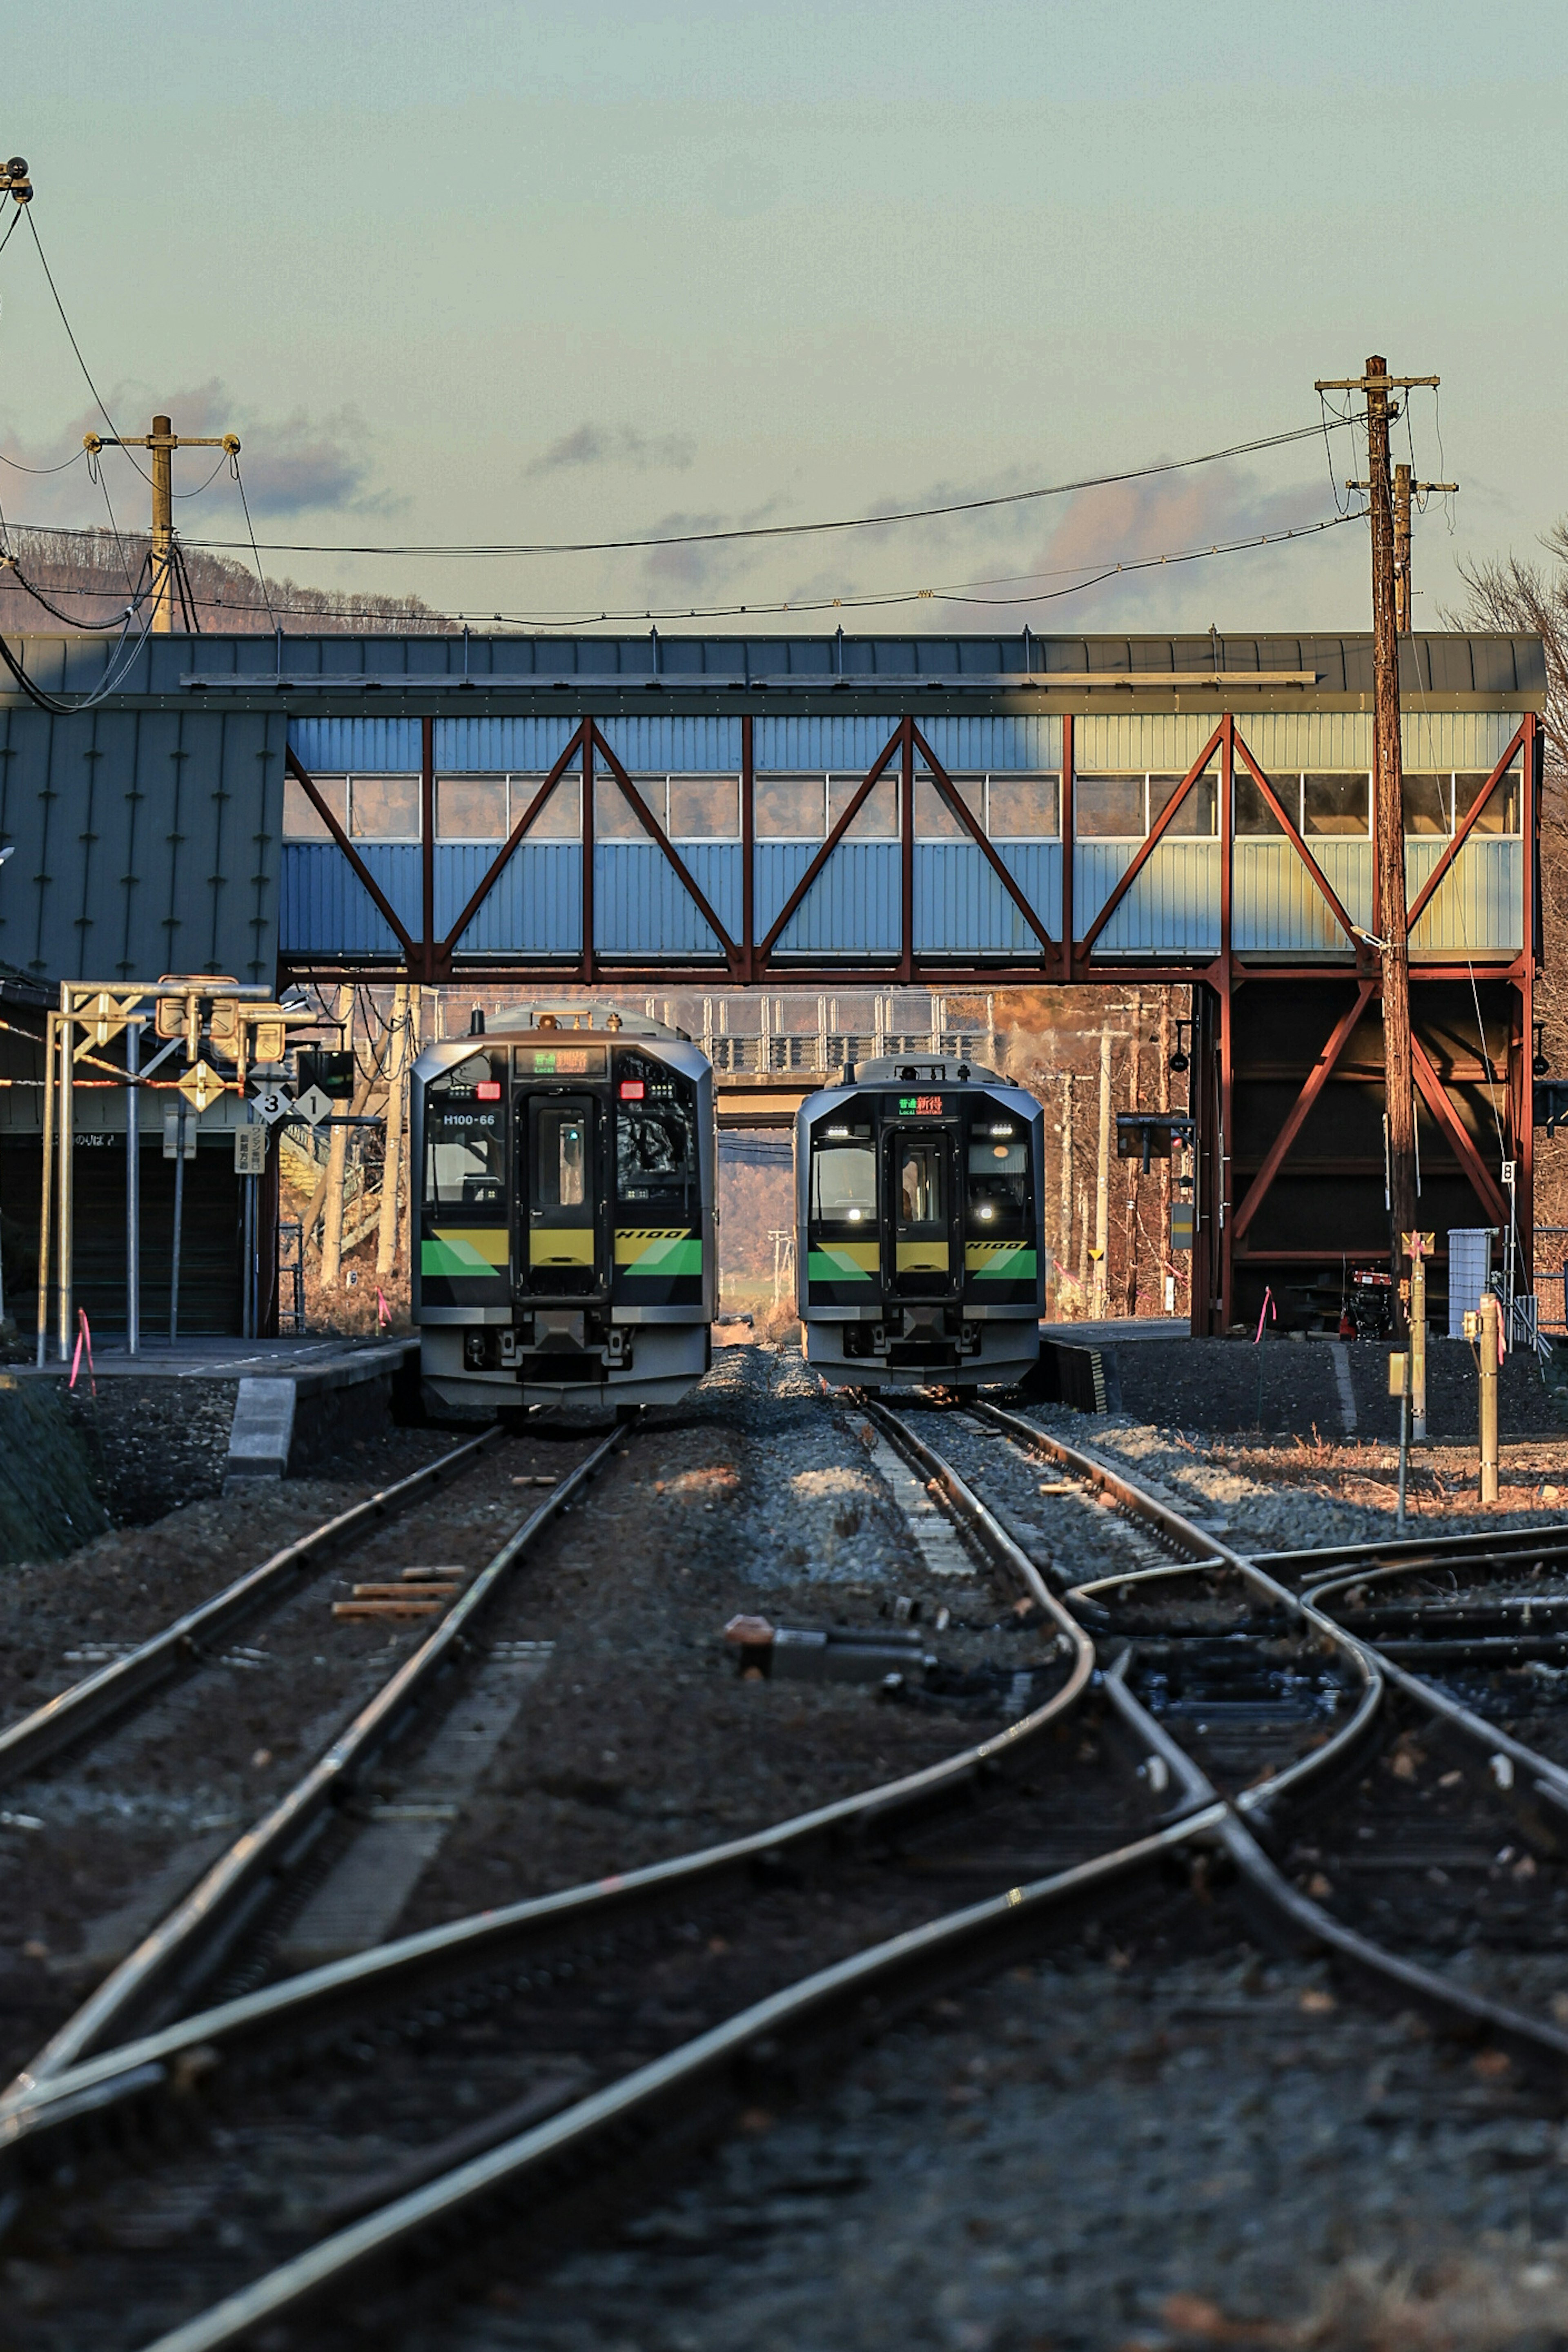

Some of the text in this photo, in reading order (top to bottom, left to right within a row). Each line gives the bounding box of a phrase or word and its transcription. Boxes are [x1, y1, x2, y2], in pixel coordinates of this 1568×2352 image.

[557, 1051, 587, 1067] 釧路
[265, 1095, 278, 1112] 3
[310, 1096, 316, 1114] 1
[899, 1096, 942, 1111] 普通 新得
[444, 1114, 495, 1125] H100-66
[1504, 1164, 1512, 1179] 8
